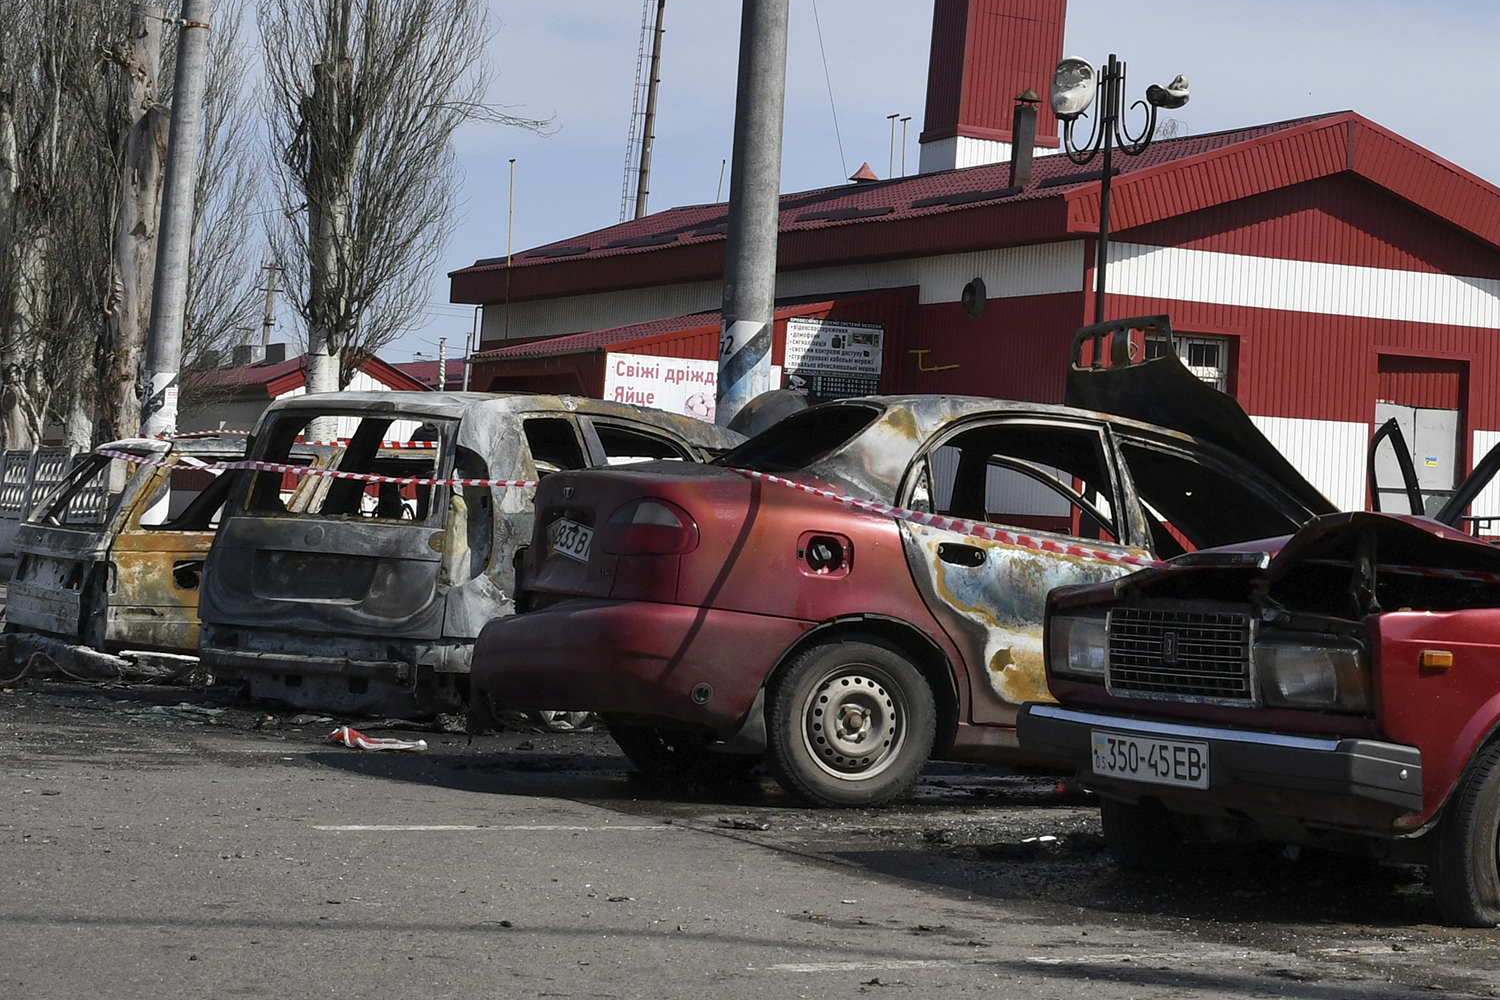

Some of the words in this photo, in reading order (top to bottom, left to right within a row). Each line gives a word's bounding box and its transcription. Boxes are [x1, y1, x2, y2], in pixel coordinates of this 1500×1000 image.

[616, 360, 660, 380] Свіжі
[664, 366, 718, 385] дріжд
[614, 386, 655, 405] Яйце
